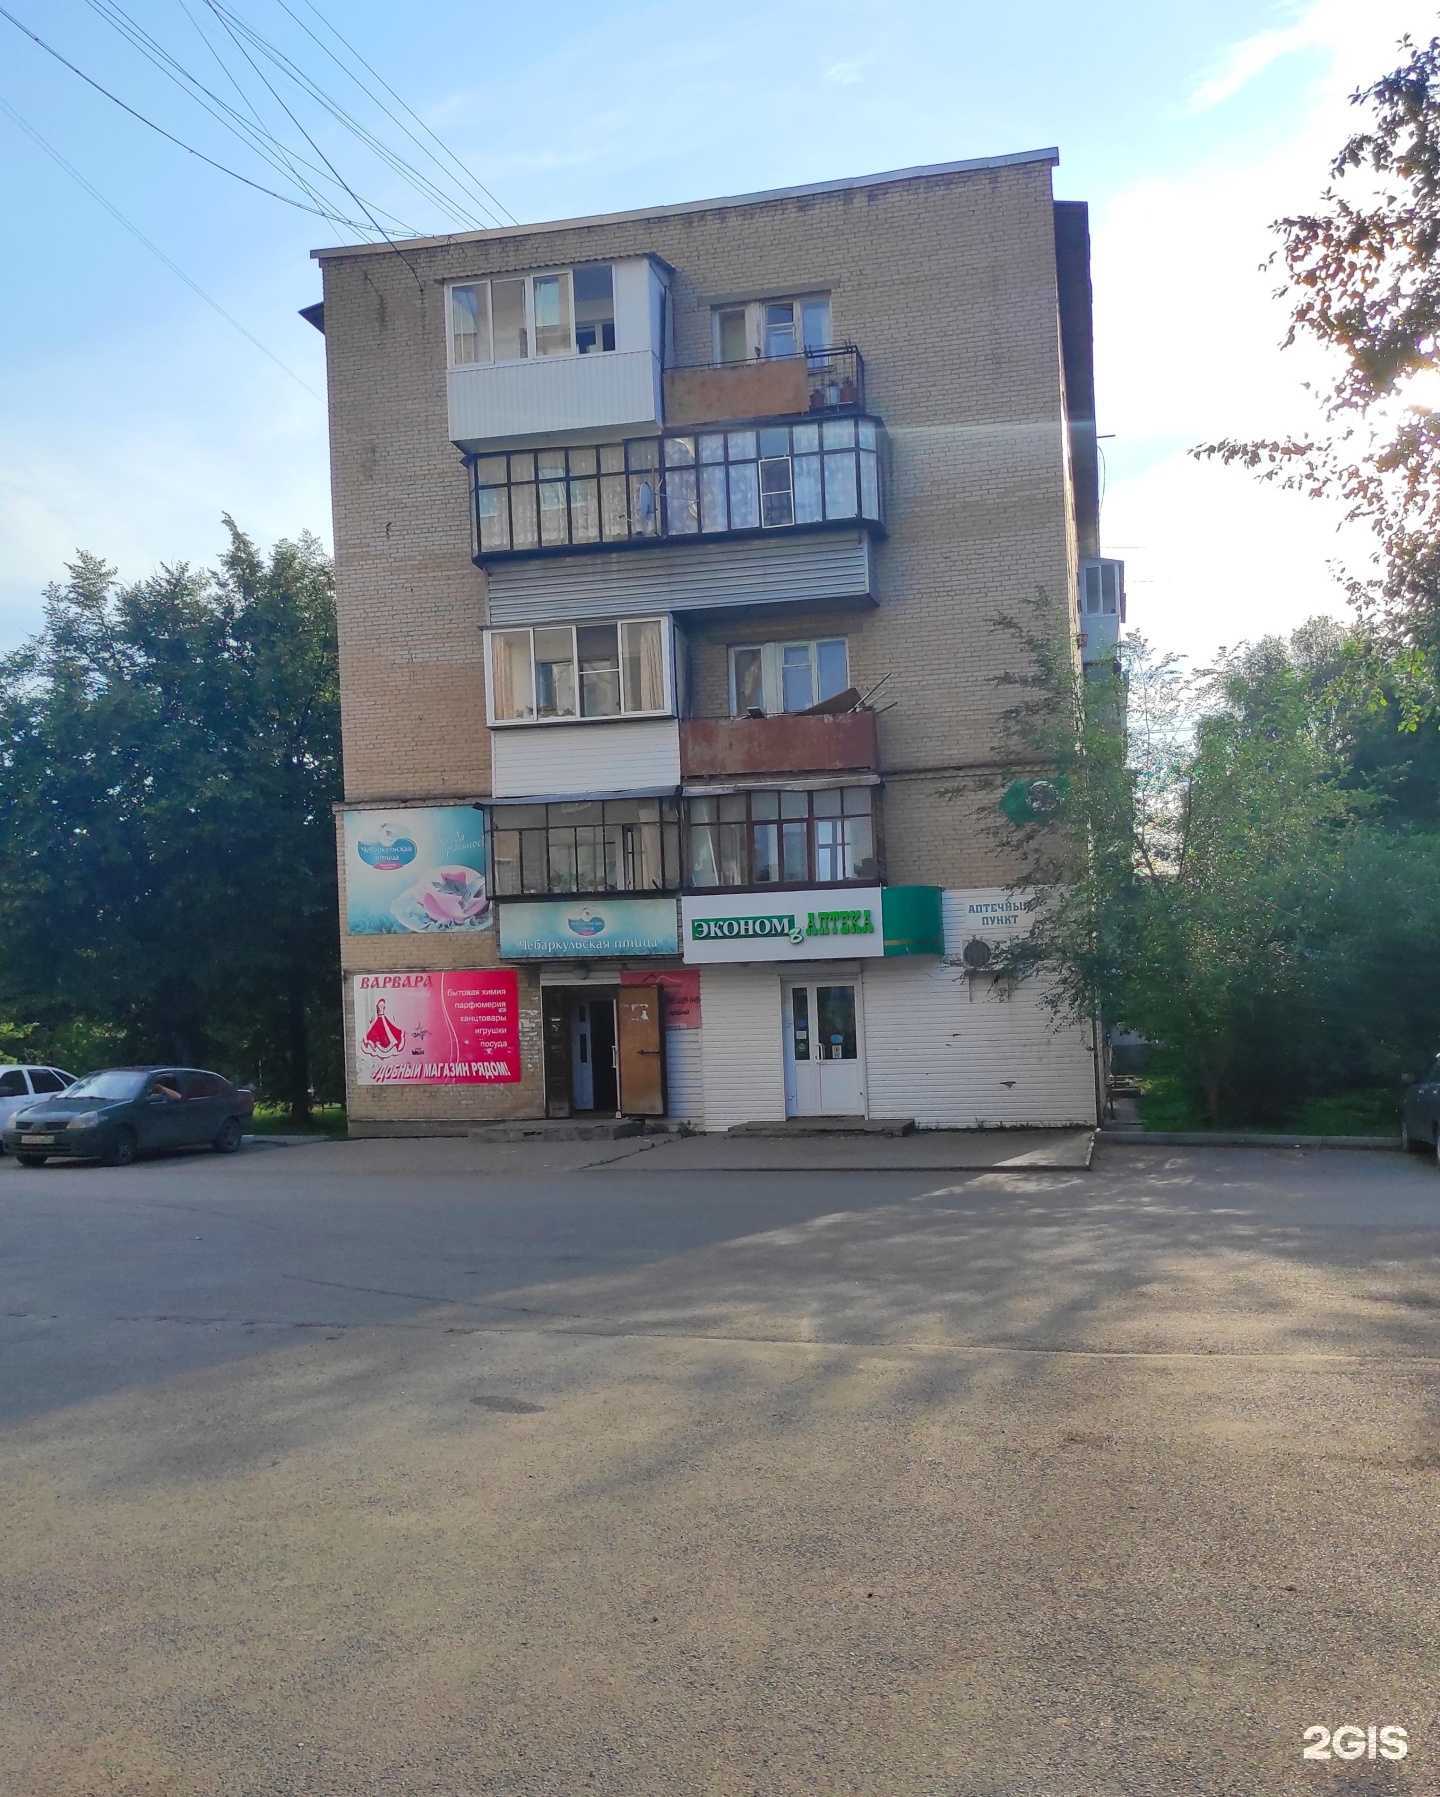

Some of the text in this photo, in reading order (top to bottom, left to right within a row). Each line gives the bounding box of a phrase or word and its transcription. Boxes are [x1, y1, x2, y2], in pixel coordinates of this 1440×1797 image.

[694, 910, 875, 938] ЭКОНОМ АПТЕКА
[982, 915, 1019, 926] ПУНКТ
[360, 975, 433, 990] ВАРВАРА
[454, 1001, 506, 1010] парфюмерия
[460, 1015, 507, 1023] канцтовары
[474, 1028, 507, 1036] игрушки
[480, 1041, 508, 1049] посуда
[423, 1062, 470, 1078] МАГАЗИН
[472, 1061, 512, 1079] РЯДОМ!
